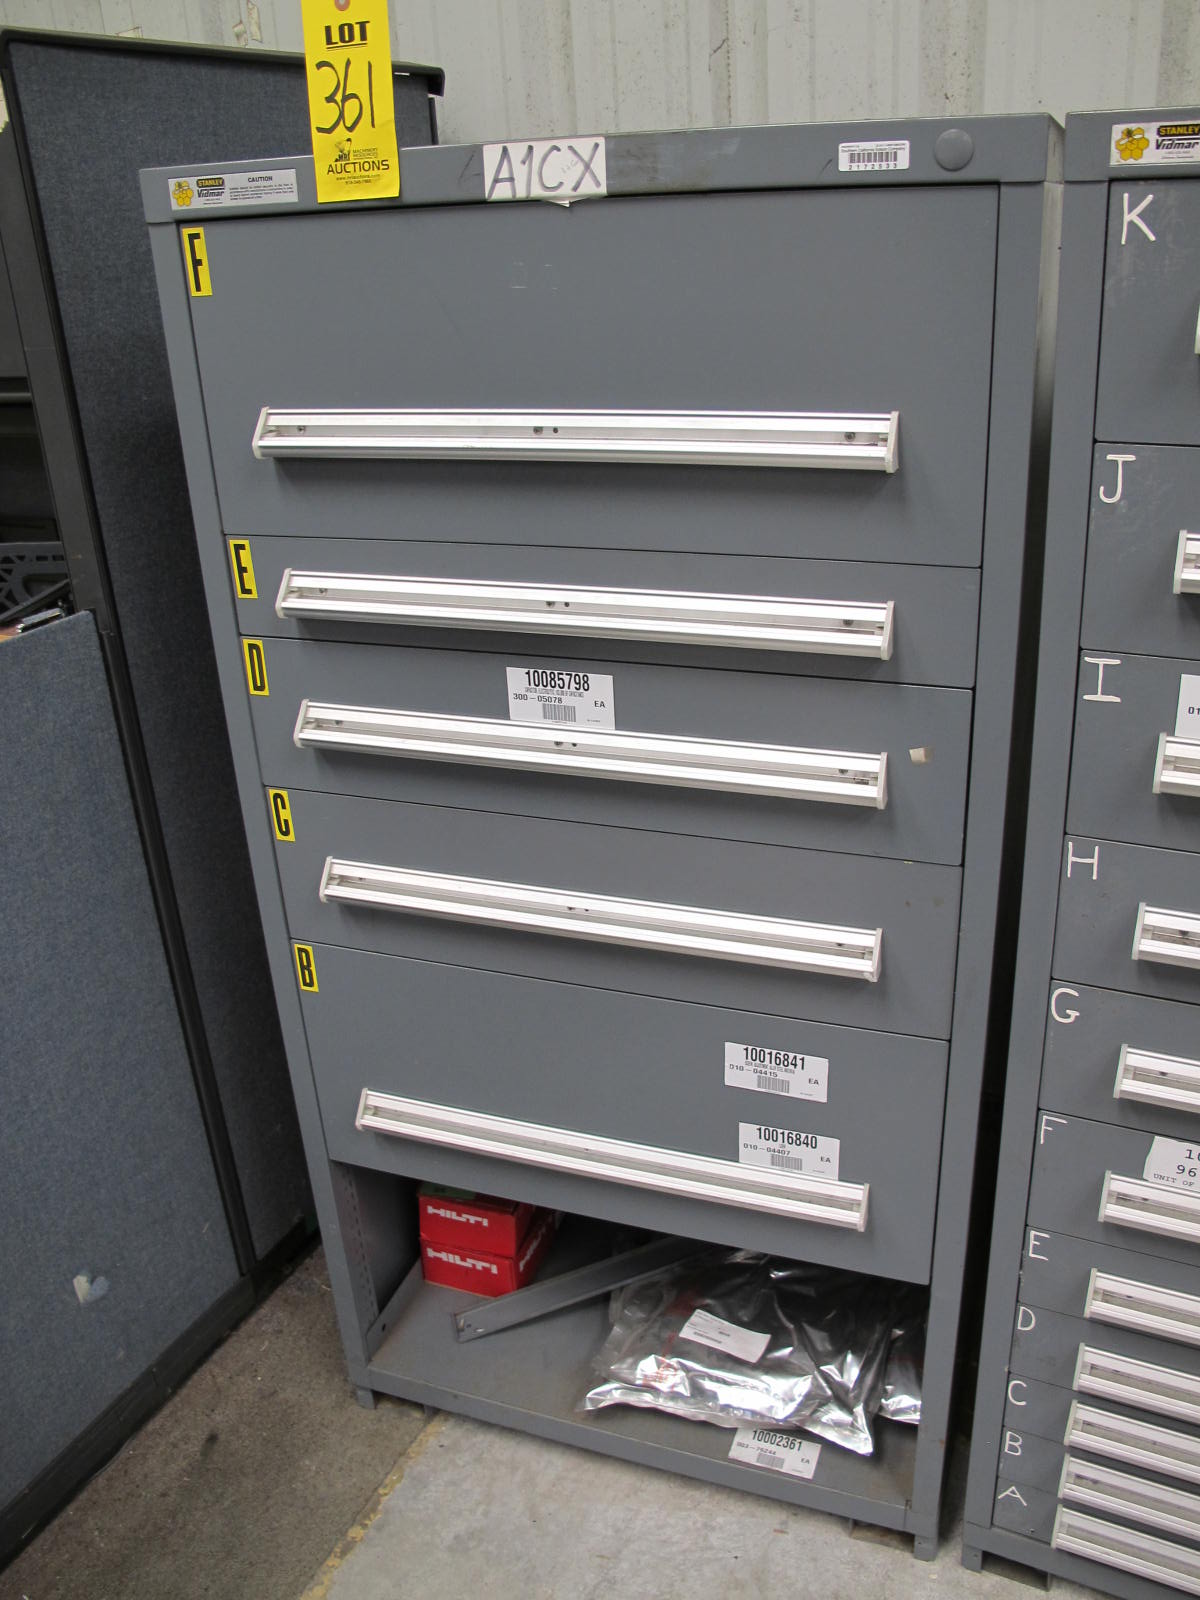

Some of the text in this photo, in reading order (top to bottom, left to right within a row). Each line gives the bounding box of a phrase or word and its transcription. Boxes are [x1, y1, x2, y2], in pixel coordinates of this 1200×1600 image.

[324, 21, 371, 46] LOT
[315, 57, 376, 134] 361
[1159, 126, 1200, 136] STANLEY
[1155, 138, 1199, 151] Vidmar
[327, 159, 390, 176] AUCTIONS
[487, 141, 602, 199] A1CX
[197, 178, 224, 187] STANLEY
[197, 188, 225, 199] Vidmar
[1121, 193, 1156, 245] K
[187, 232, 204, 293] F
[1099, 454, 1137, 504] J
[233, 543, 253, 596] E
[248, 643, 266, 692] D
[1083, 656, 1122, 703] I
[525, 670, 590, 691] 10085798
[594, 700, 606, 709] EA
[270, 792, 290, 837] C
[1066, 841, 1099, 881] H
[297, 946, 315, 989] B
[1050, 987, 1081, 1024] G
[743, 1046, 806, 1071] 10016841
[808, 1077, 820, 1086] EA
[756, 1126, 818, 1150] 10016840
[1039, 1115, 1068, 1146] F
[820, 1155, 831, 1163] EA
[1153, 1173, 1177, 1184] UNIT
[426, 1204, 489, 1228] HILTI
[1028, 1230, 1050, 1261] E
[426, 1246, 499, 1275] HILTI
[1017, 1306, 1036, 1331] D
[1008, 1380, 1027, 1406] C
[752, 1429, 803, 1452] 10002361
[1004, 1430, 1023, 1456] B
[997, 1485, 1028, 1507] A
